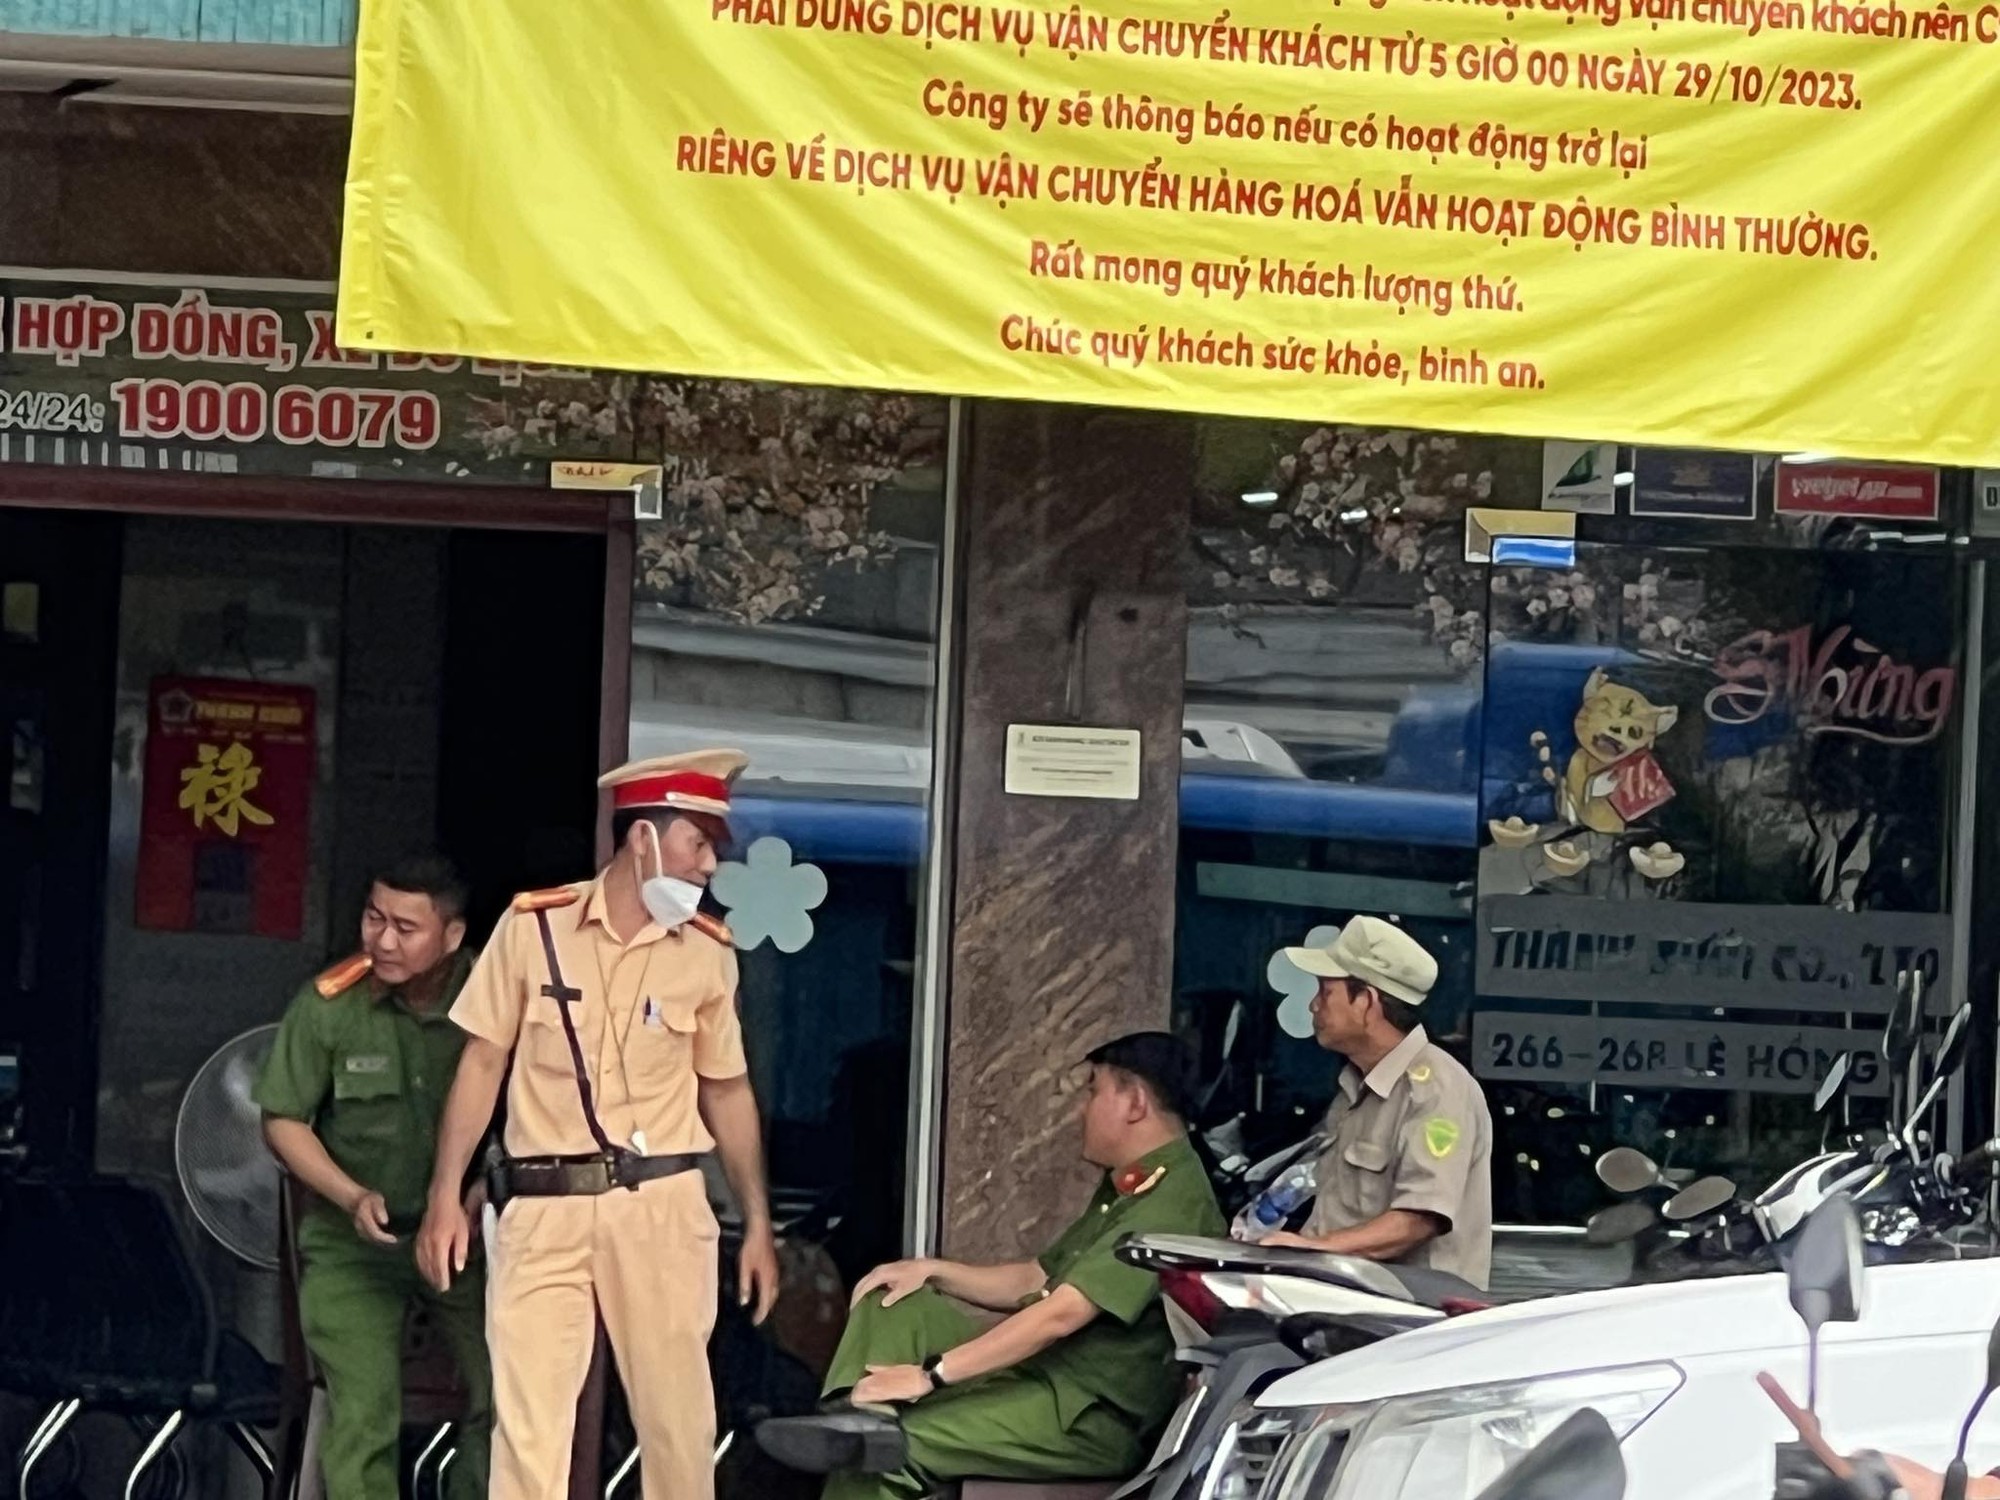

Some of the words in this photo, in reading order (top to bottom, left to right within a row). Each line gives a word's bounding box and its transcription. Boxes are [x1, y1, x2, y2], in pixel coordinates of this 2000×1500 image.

[903, 2, 980, 49] DỊCH
[992, 9, 1033, 57] VỤ
[1046, 6, 1107, 60] VẬN
[1119, 10, 1249, 60] CHUYỂN
[1259, 24, 1371, 70] KHÁCH
[1381, 31, 1424, 74] TỪ
[1430, 43, 1446, 77] 5
[1457, 38, 1517, 81] GIỜ
[1528, 52, 1567, 86] 00
[1578, 49, 1663, 94] NGÀY
[1675, 64, 1861, 109] 29/10/2023.
[1813, 0, 1906, 38] khách
[1912, 3, 1968, 41] nên
[1976, 5, 2000, 43] C
[924, 79, 1007, 130] Công
[1018, 91, 1049, 132] ty
[1058, 90, 1093, 127] sẽ
[1103, 94, 1193, 144] thông
[1205, 101, 1264, 139] báo
[1274, 105, 1331, 143] nếu
[1341, 114, 1377, 147] có
[1387, 115, 1459, 164] hoạt
[1469, 123, 1548, 171] động
[1558, 128, 1602, 165] trở
[1611, 131, 1647, 178] lại
[678, 128, 775, 177] RIÊNG
[834, 149, 911, 196] DỊCH
[921, 155, 965, 204] VỤ
[977, 153, 1038, 208] VẬN
[1049, 157, 1180, 209] CHUYỂN
[1190, 169, 1283, 216] HÀNG
[1293, 179, 1362, 223] HOÁ
[1375, 176, 1437, 229] VẪN
[1448, 196, 1534, 246] HOẠT
[1544, 197, 1640, 251] ĐỘNG
[1652, 203, 1723, 248] BÌNH
[1737, 212, 1876, 260] THƯỜNG.
[1031, 240, 1082, 278] Rất
[1094, 254, 1183, 297] mong
[1192, 258, 1250, 299] quý
[1260, 258, 1353, 298] khách
[1365, 265, 1451, 315] lượng
[1462, 274, 1525, 312] thứ.
[14, 295, 124, 366] HỢP
[302, 310, 379, 370] X
[1000, 313, 1082, 355] Chúc
[1090, 324, 1150, 369] quý
[1159, 327, 1252, 366] khách
[1262, 336, 1316, 374] sức
[1500, 363, 1544, 388] an.
[110, 378, 267, 442] 1900
[273, 384, 440, 450] 6079
